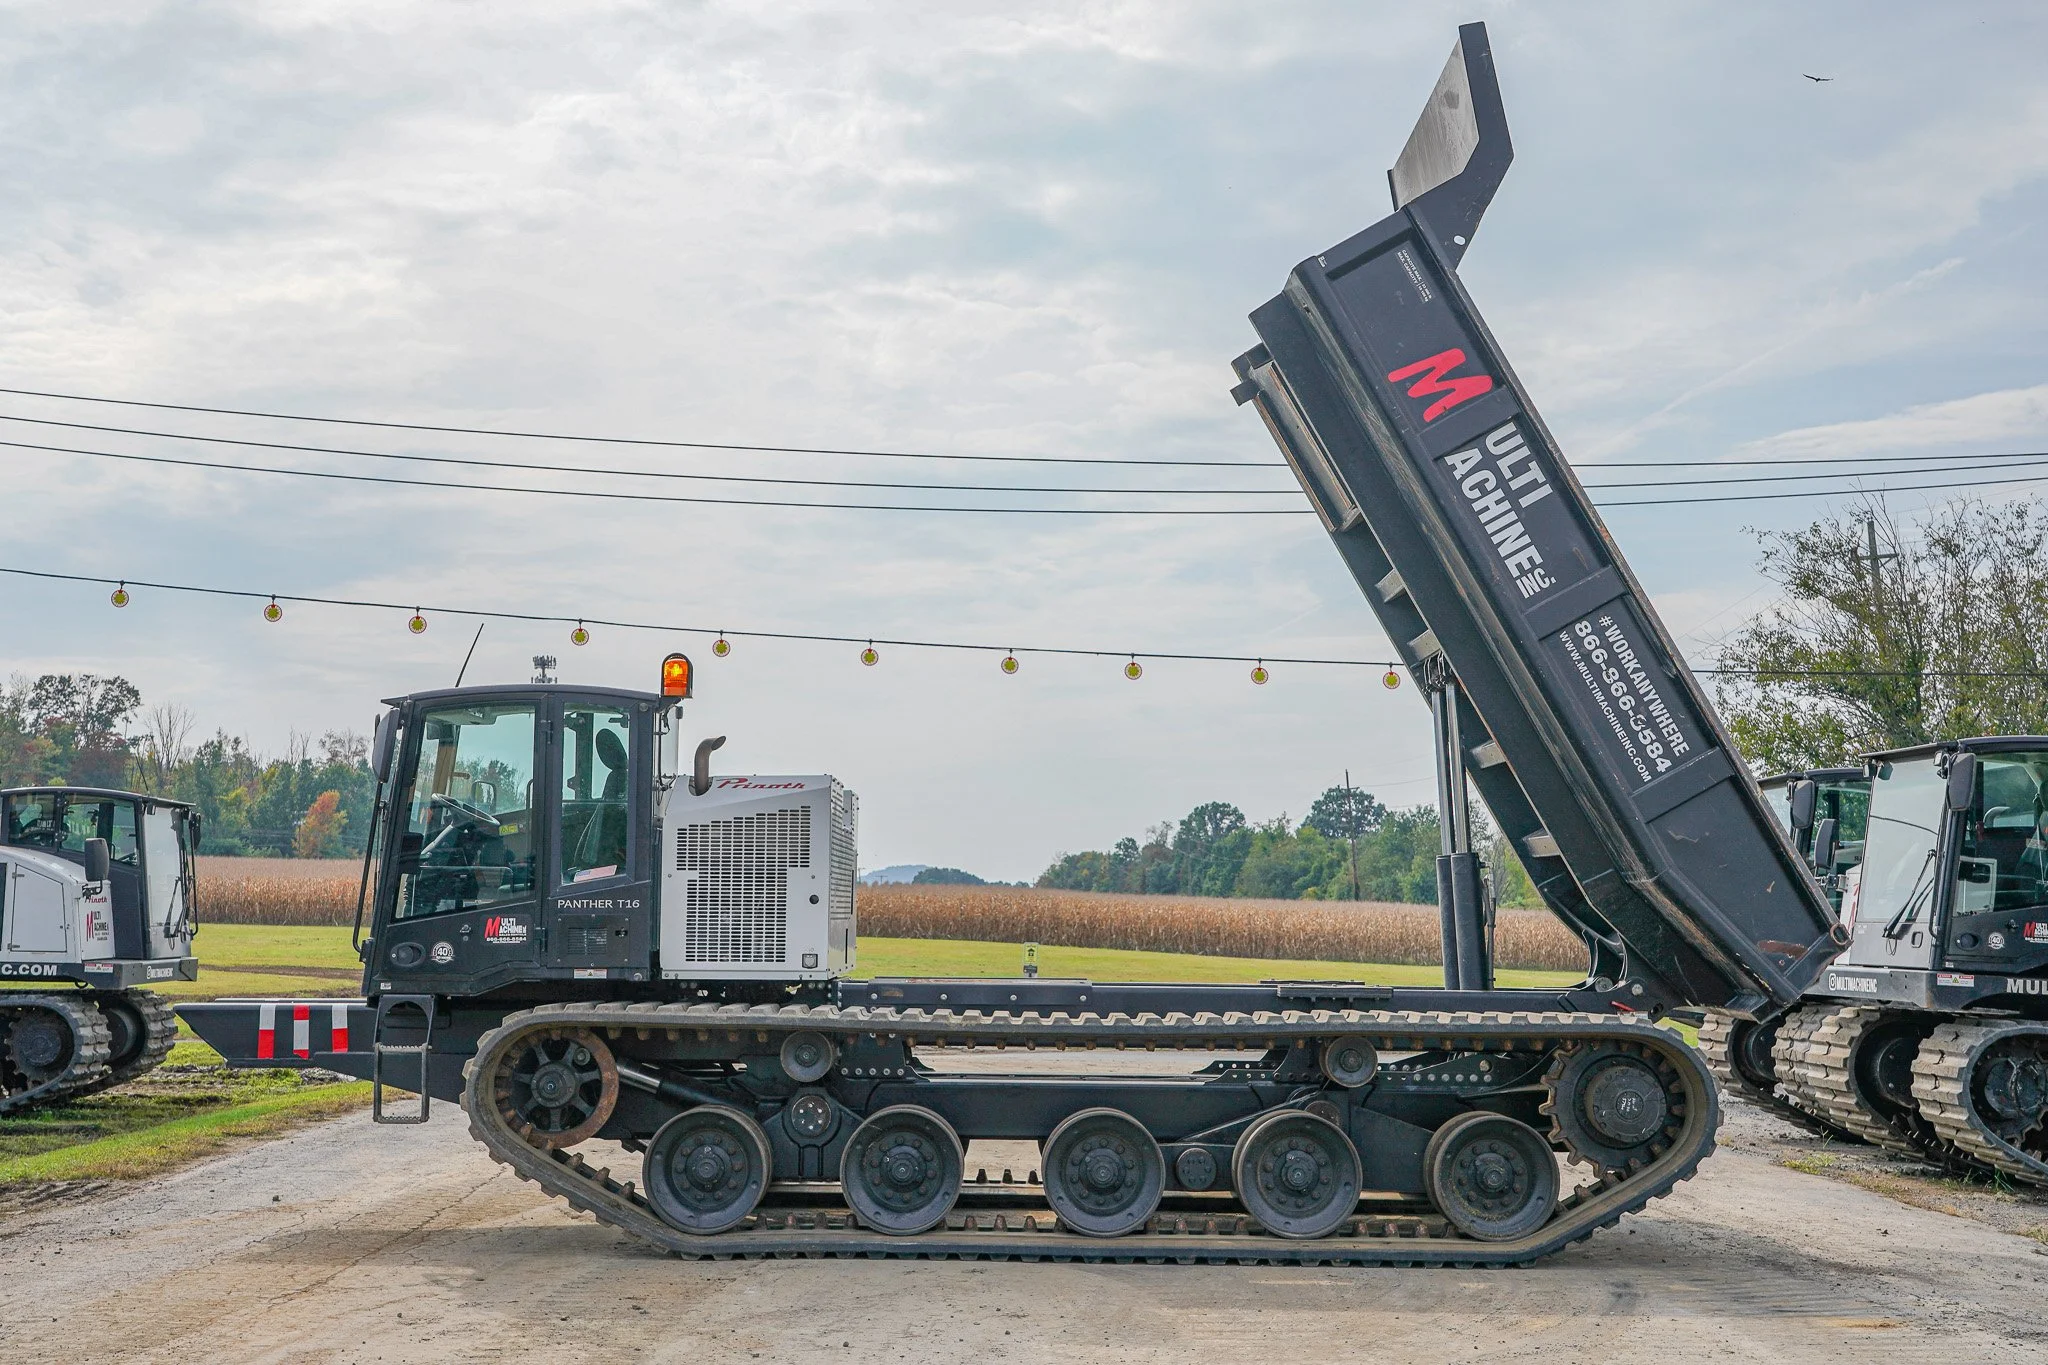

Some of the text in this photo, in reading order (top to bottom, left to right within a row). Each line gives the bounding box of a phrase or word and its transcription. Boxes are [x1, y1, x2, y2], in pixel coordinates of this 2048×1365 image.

[1404, 263, 1418, 284] CAPACITY
[1444, 447, 1557, 599] ACHINE INC.
[1574, 620, 1672, 773] 866-866-8584
[1599, 615, 1690, 757] #WORKANYWHERE
[1559, 630, 1652, 782] WWW.MULTIMACHINEINC.COM
[716, 777, 806, 789] Prinoth
[557, 899, 640, 909] PANTHER T16
[437, 947, 449, 956] 40
[1, 963, 58, 977] C.COM
